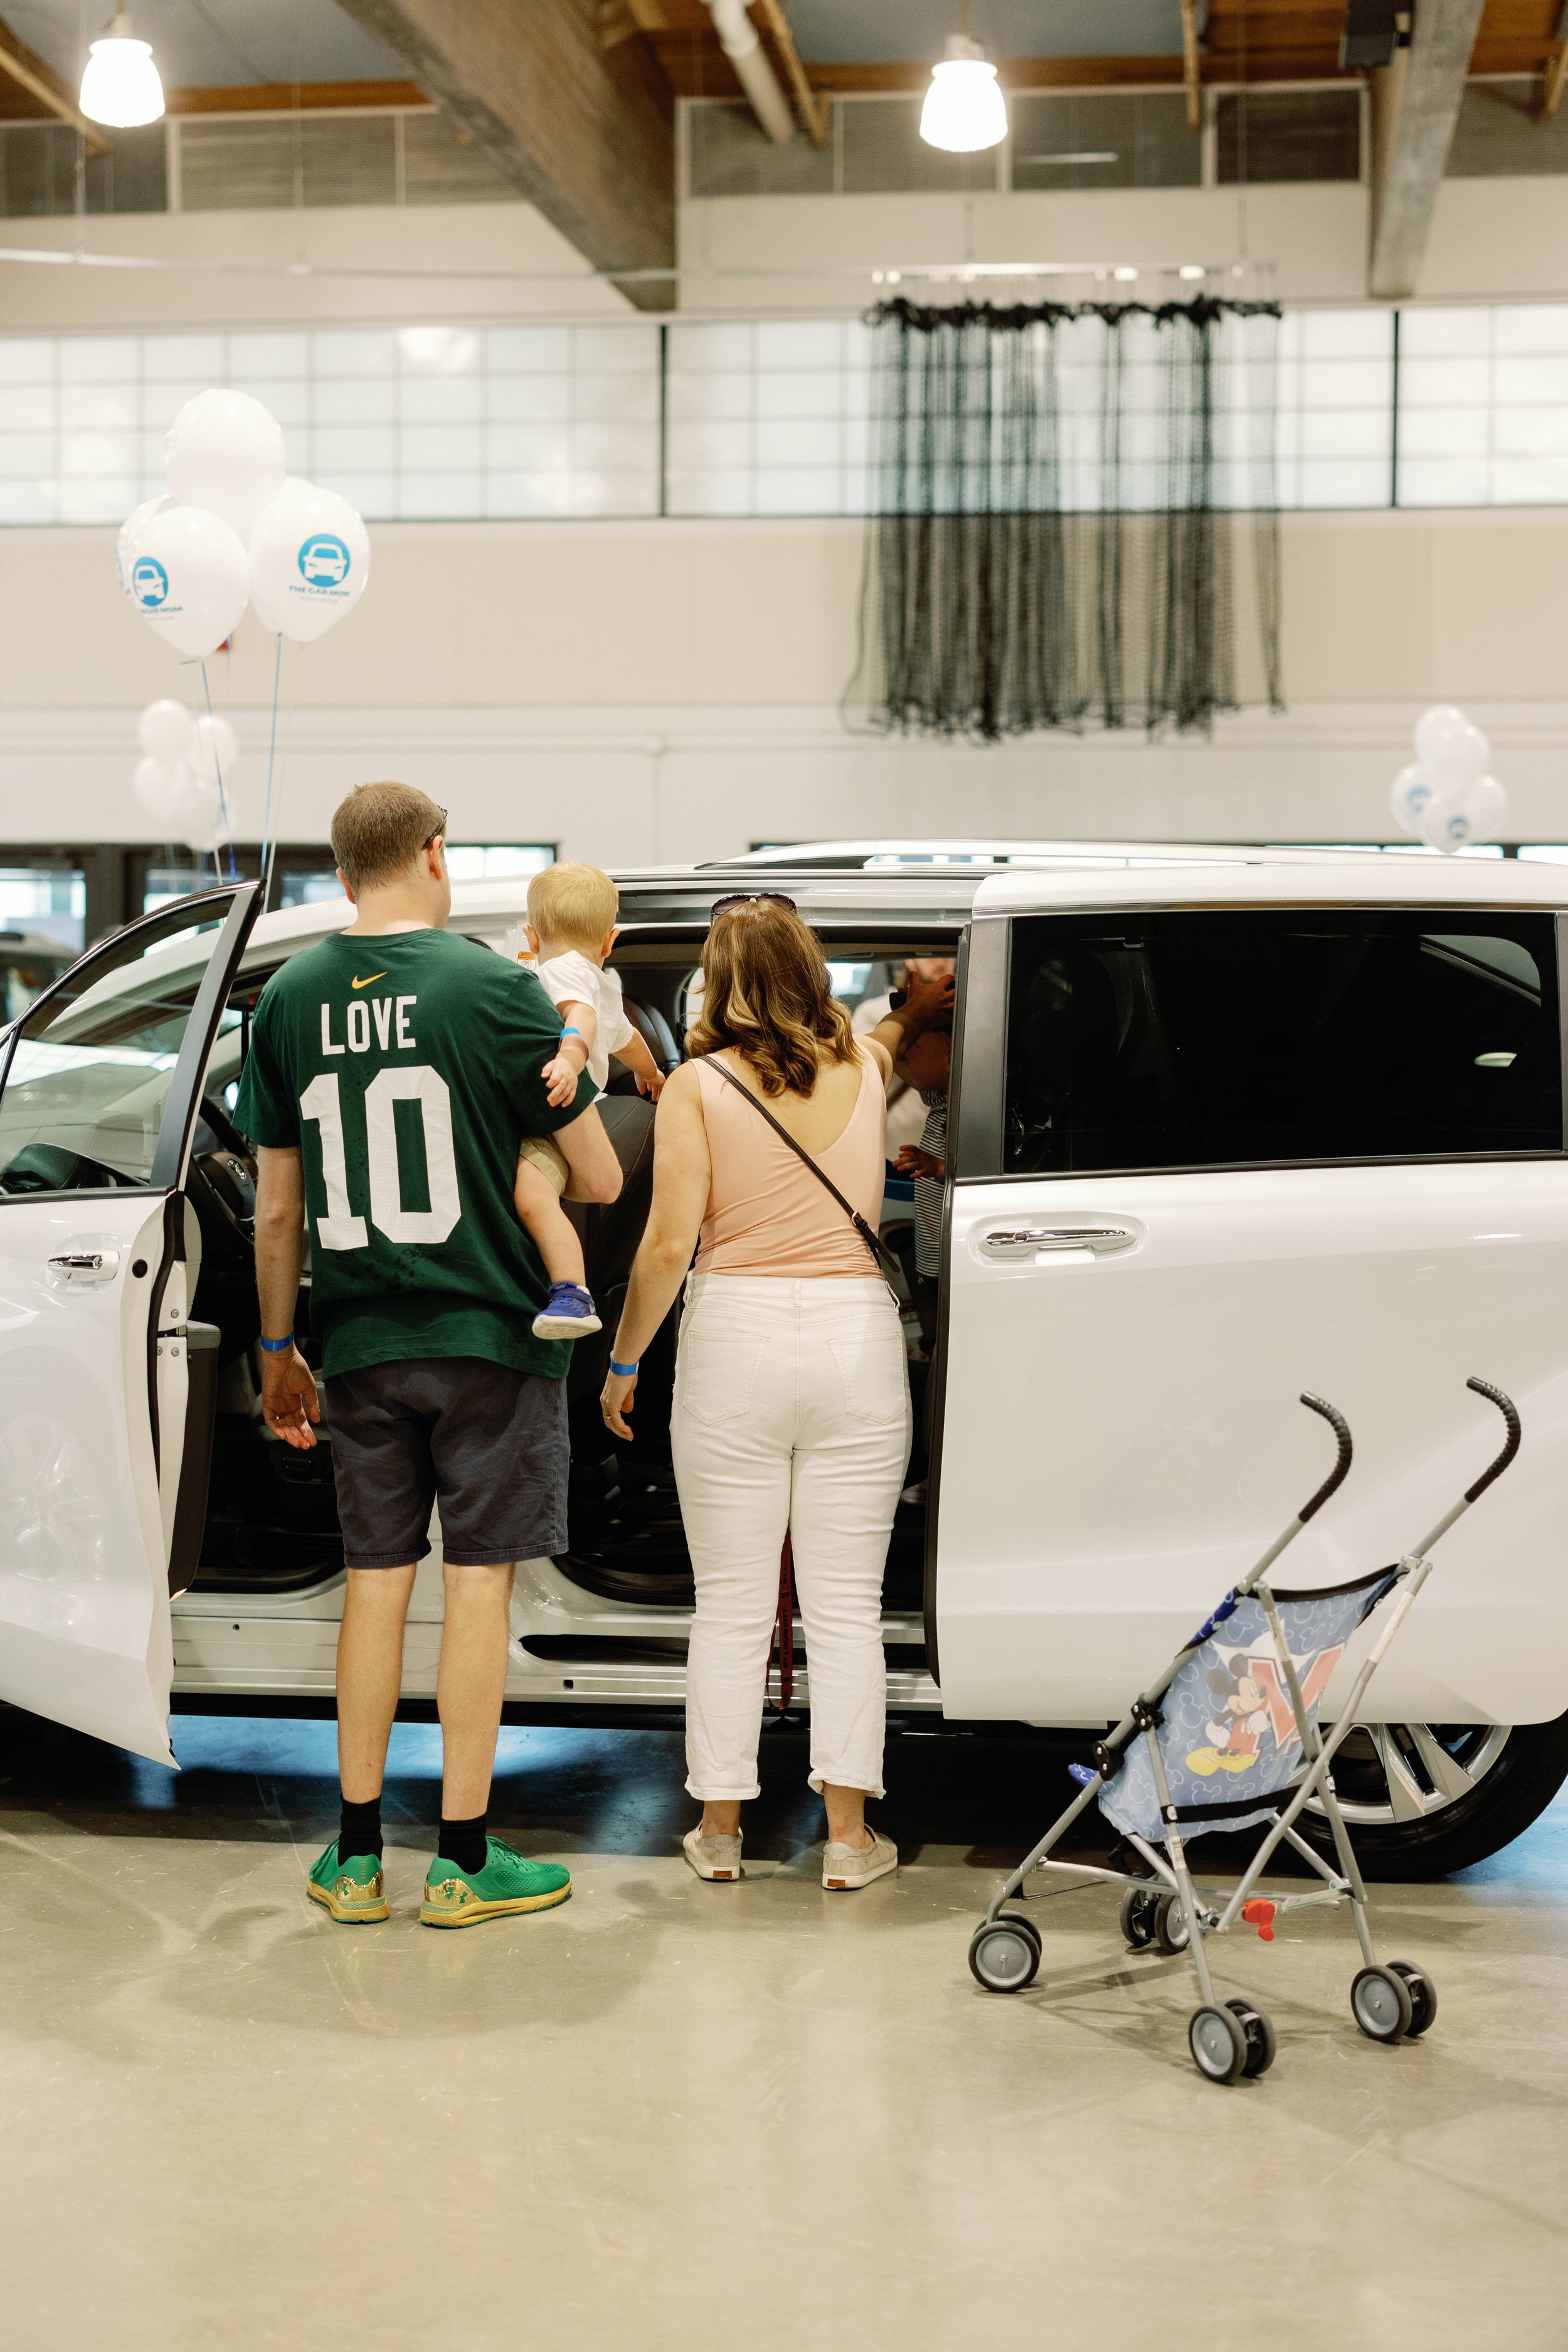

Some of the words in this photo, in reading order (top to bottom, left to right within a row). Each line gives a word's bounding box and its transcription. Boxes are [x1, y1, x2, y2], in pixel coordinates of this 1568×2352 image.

[321, 995, 417, 1056] LOVE
[299, 1065, 462, 1251] 10
[783, 1656, 788, 1668] ST
